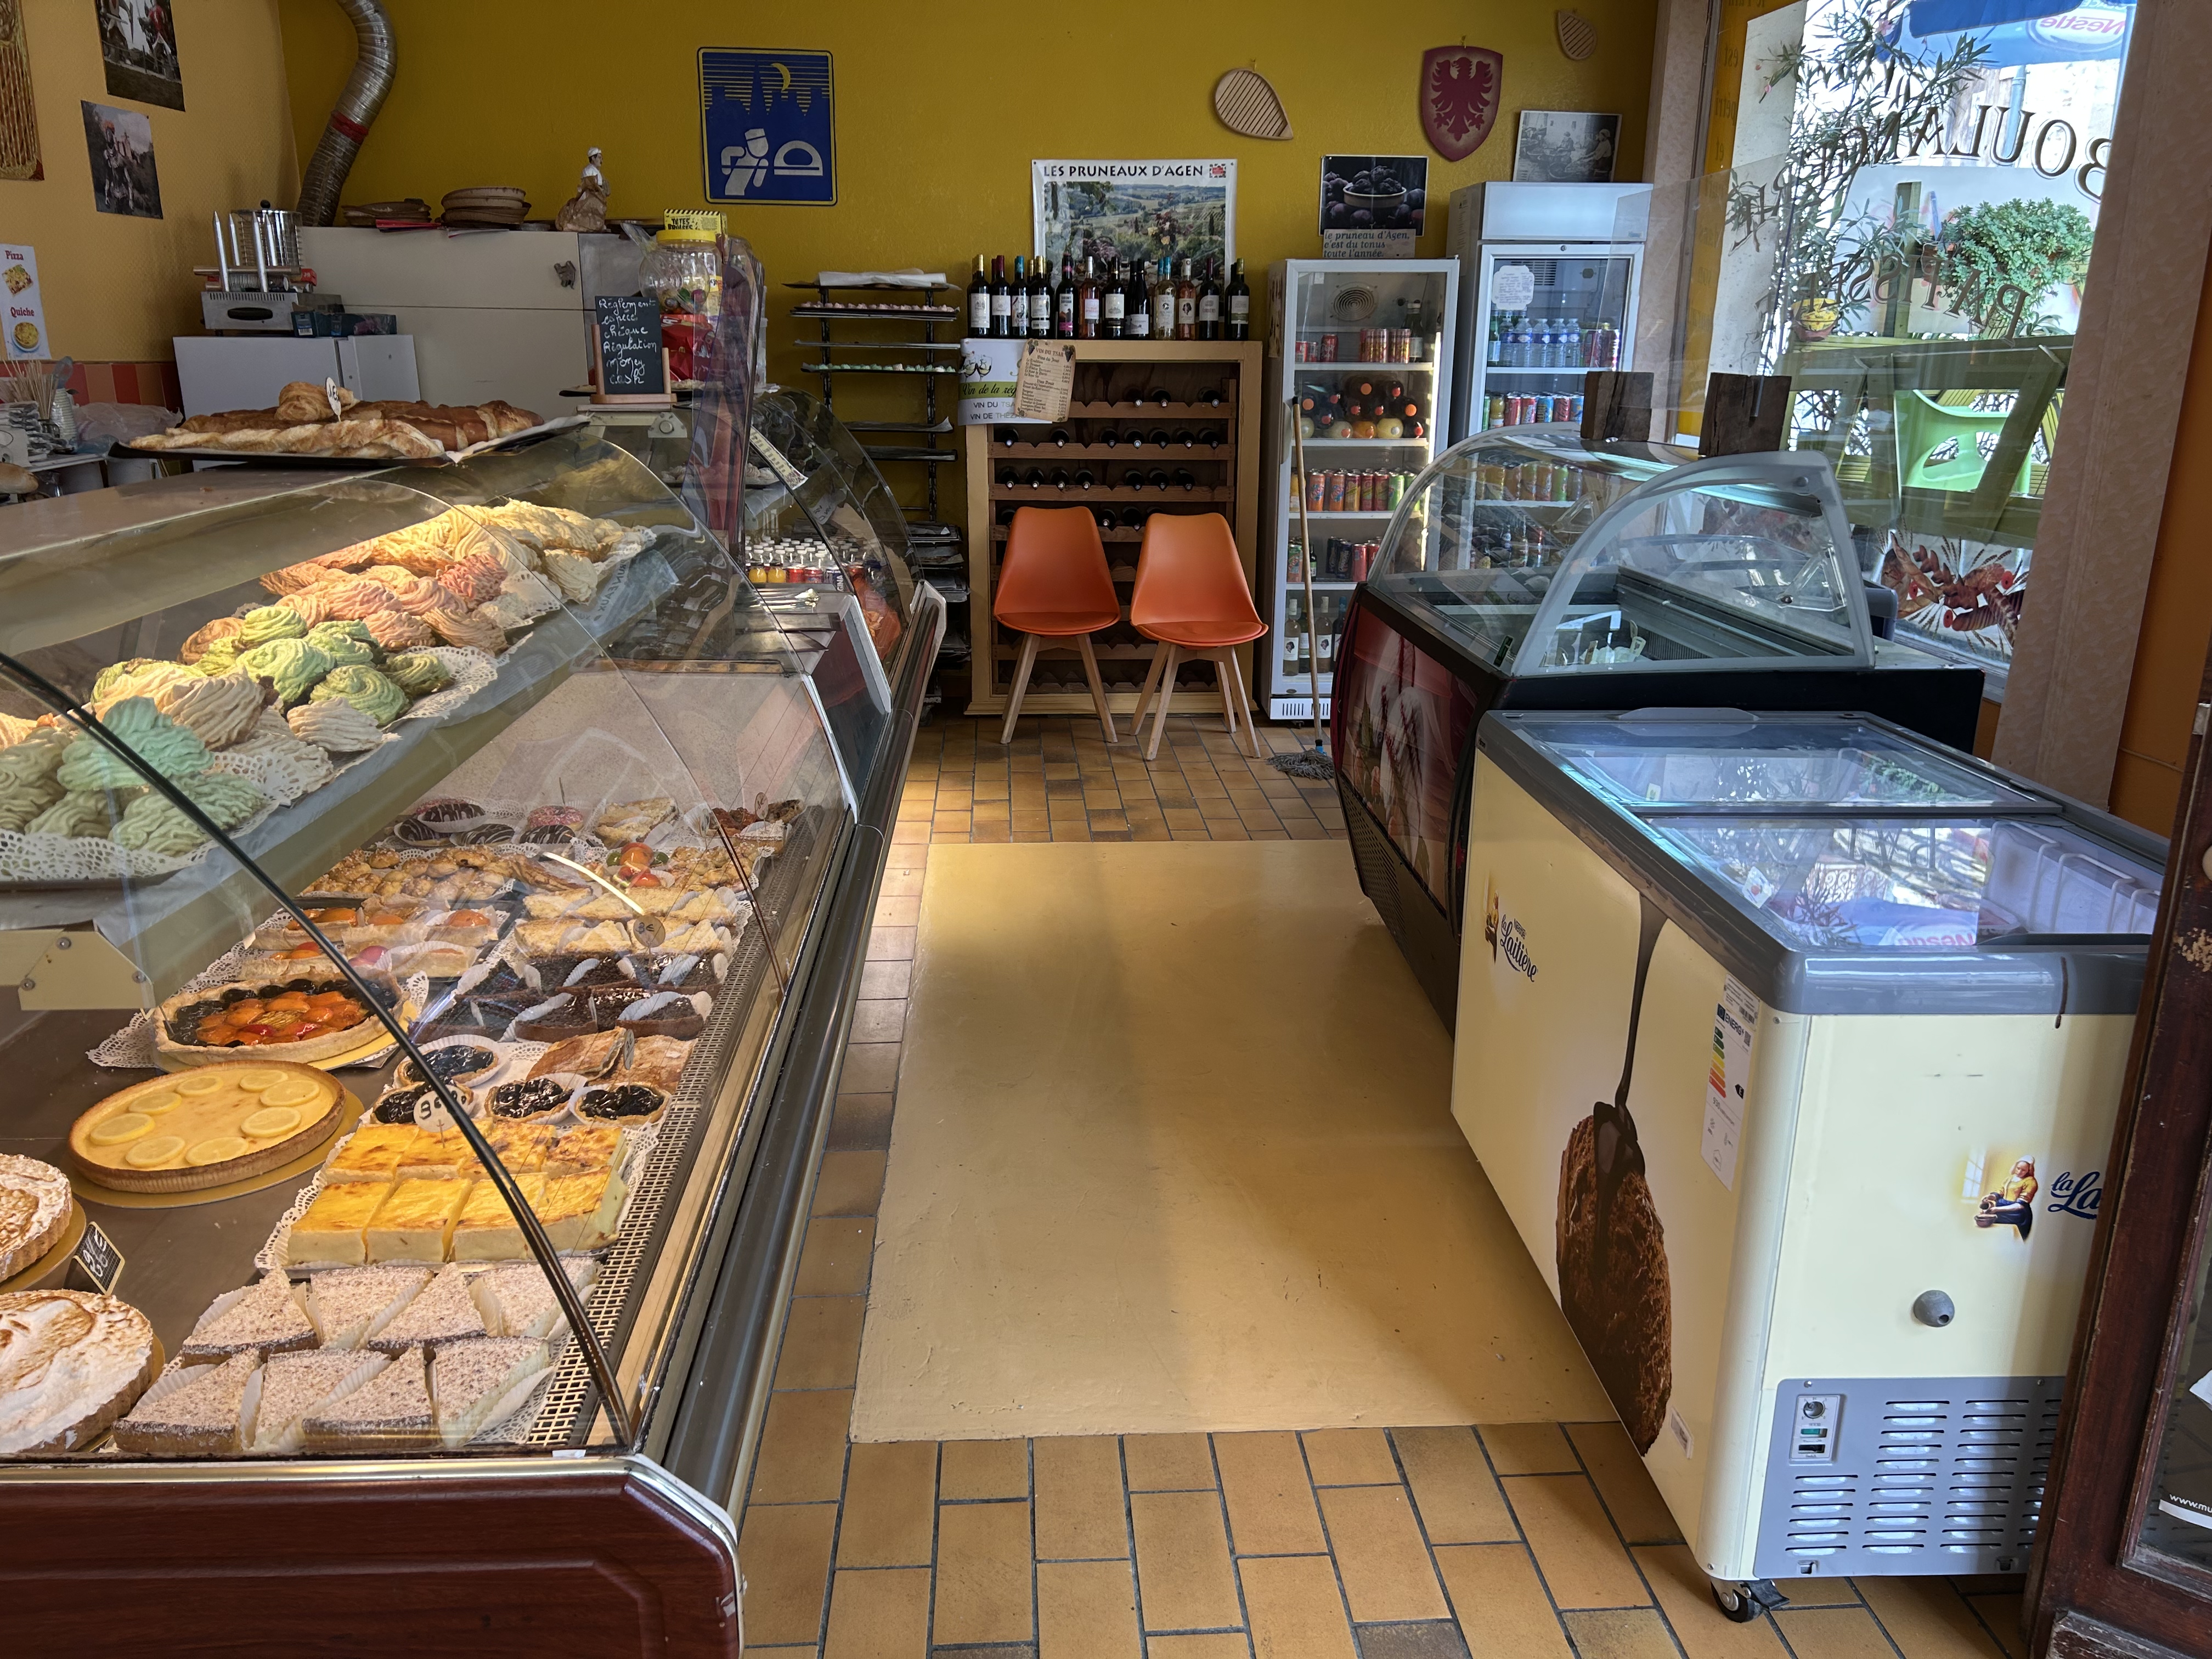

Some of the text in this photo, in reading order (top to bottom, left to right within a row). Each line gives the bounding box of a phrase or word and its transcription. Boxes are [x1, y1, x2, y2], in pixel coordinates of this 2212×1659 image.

[1043, 165, 1064, 177] LES
[1069, 165, 1147, 177] PRUNEAUX
[1152, 165, 1204, 177] D'AGEN
[1324, 230, 1410, 241] le pruneau d'Agen,
[1324, 240, 1385, 249] c'est du tonus
[5, 250, 24, 261] Pizza
[1324, 250, 1346, 258] toute
[10, 307, 35, 318] Quiche
[610, 368, 645, 385] cash
[962, 382, 1017, 398] Vin de la rég
[1500, 921, 1537, 983] Laitière
[2047, 1171, 2103, 1220] la La
[2169, 1493, 2212, 1514] www.mu
